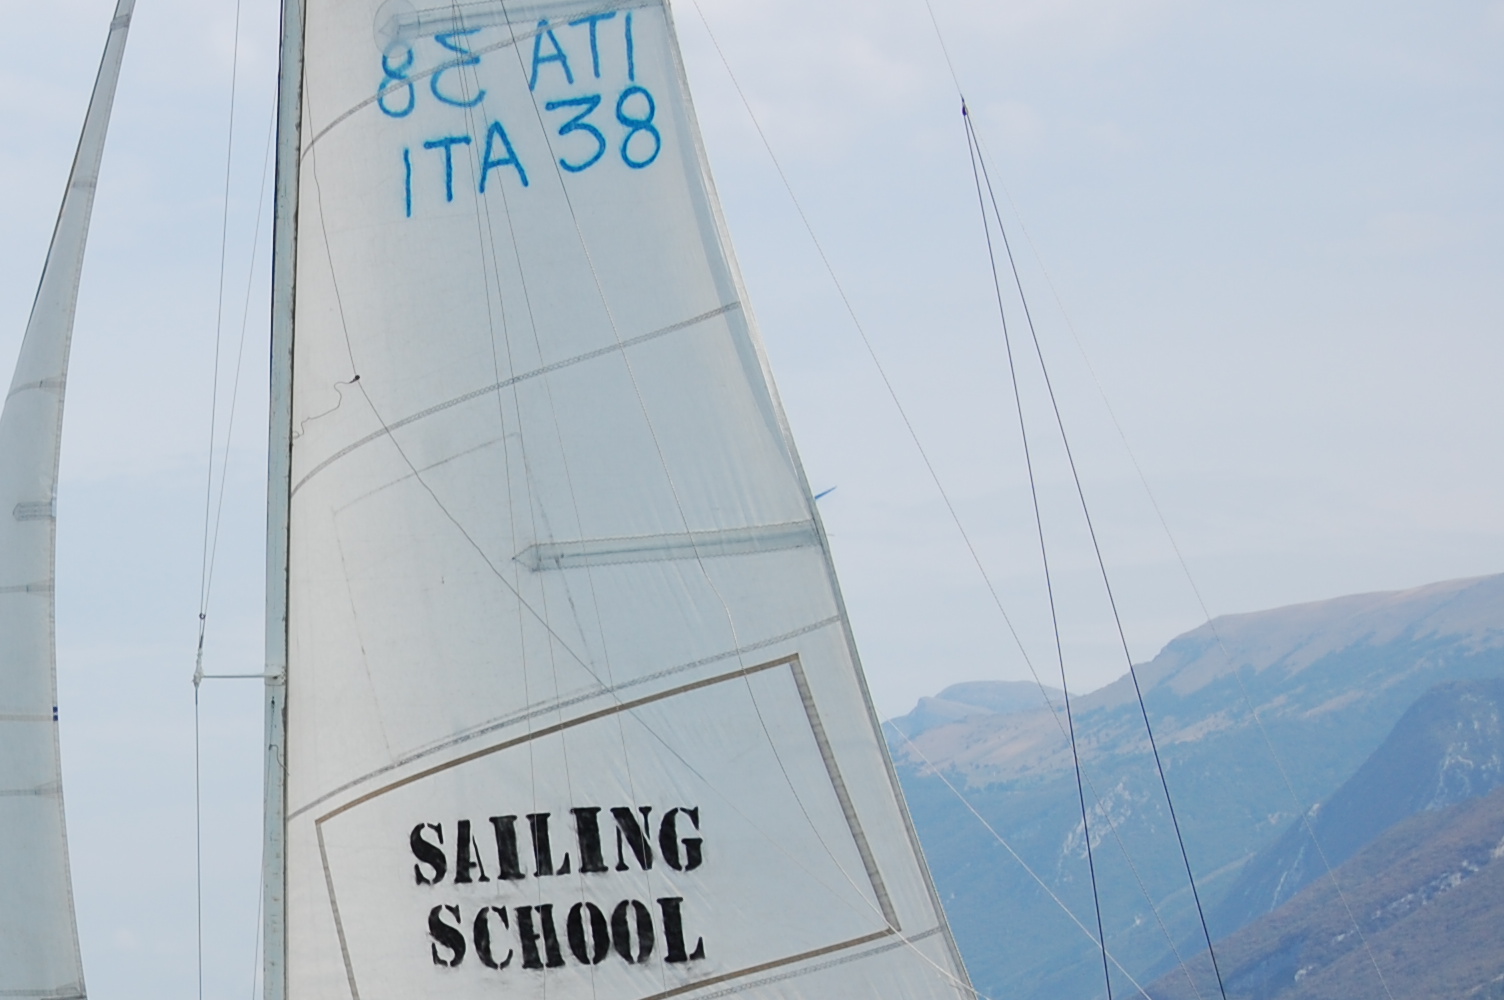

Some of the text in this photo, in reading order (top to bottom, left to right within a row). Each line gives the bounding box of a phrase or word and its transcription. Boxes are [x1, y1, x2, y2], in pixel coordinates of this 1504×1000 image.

[403, 86, 661, 218] ITA 38
[409, 806, 704, 885] SAILING
[428, 897, 705, 969] SCHOOL
